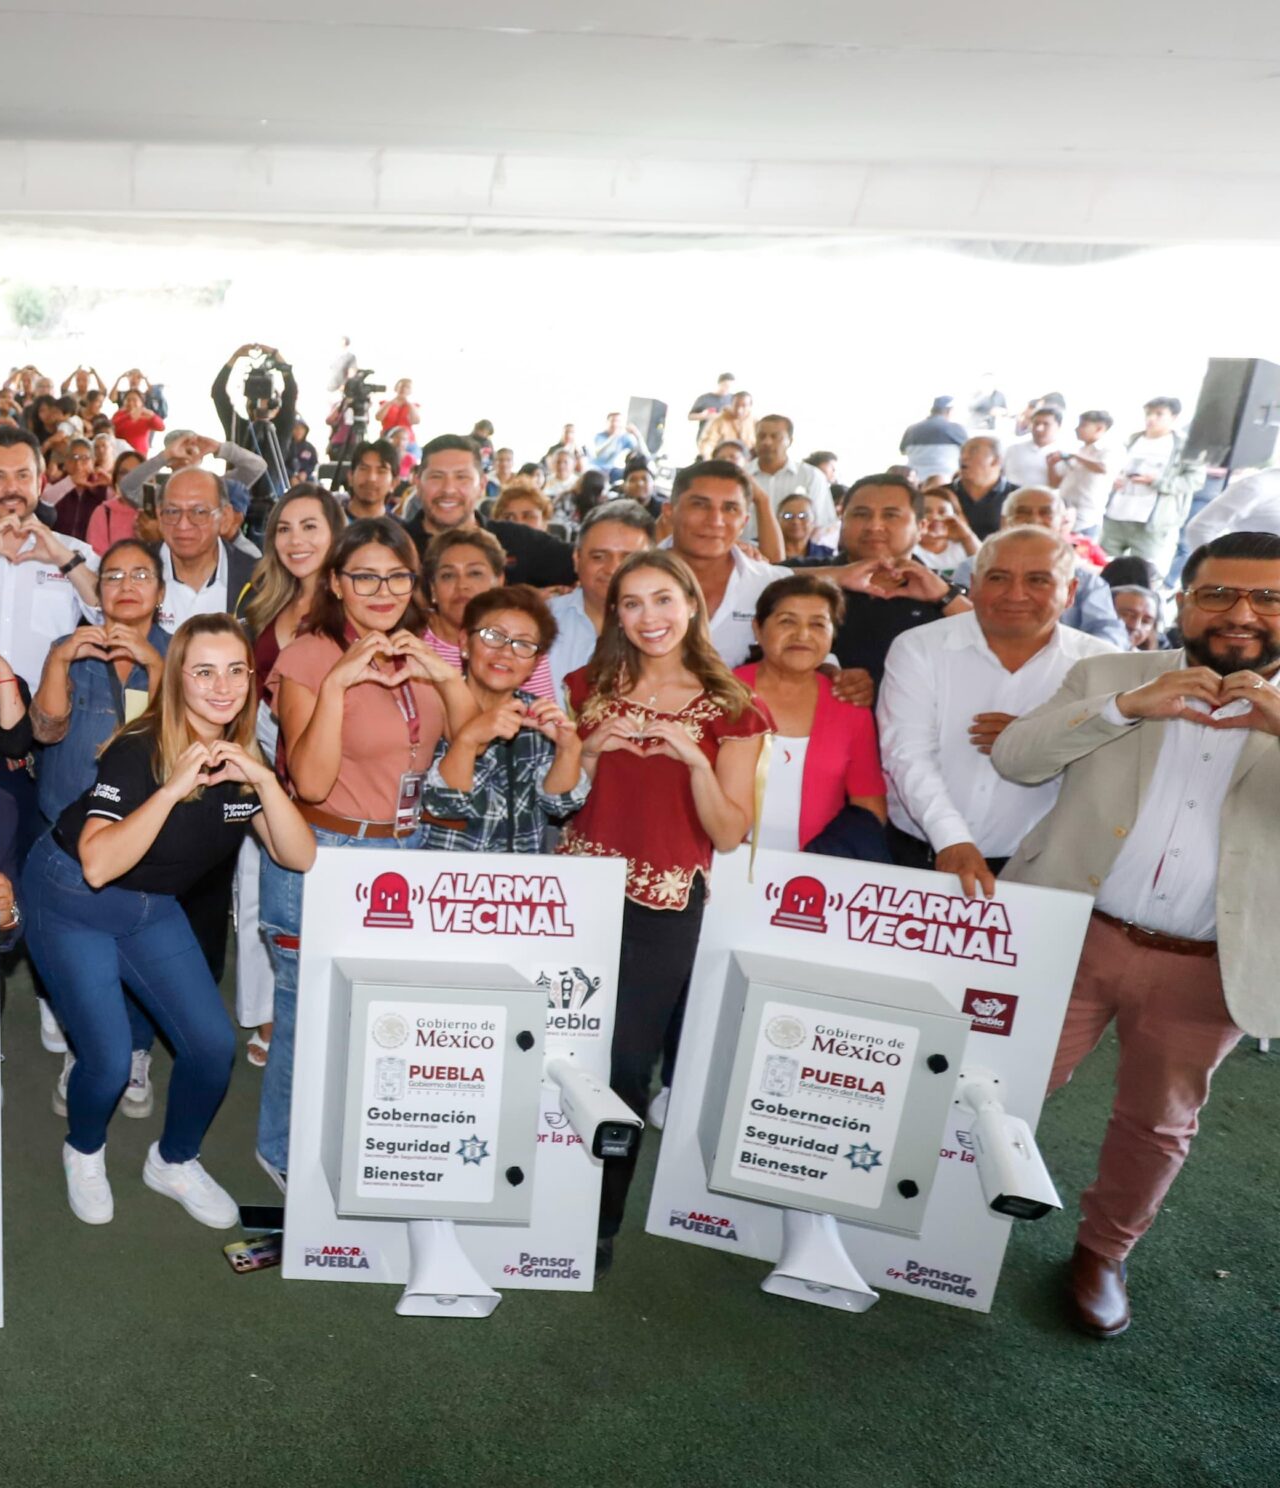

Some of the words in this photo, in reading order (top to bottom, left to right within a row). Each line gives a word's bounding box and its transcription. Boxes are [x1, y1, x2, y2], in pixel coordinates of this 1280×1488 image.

[428, 872, 567, 906] ALARMA
[429, 901, 574, 937] VECINAL
[846, 883, 1012, 935] ALARMA
[848, 909, 1017, 967] VECINAL
[416, 1018, 477, 1030] Gobierno
[481, 1020, 496, 1031] de
[546, 1013, 601, 1031] uebla
[415, 1029, 494, 1049] México
[814, 1024, 884, 1045] Gobierno
[887, 1038, 905, 1049] de
[811, 1035, 901, 1066] México
[409, 1065, 484, 1081] PUEBLA
[800, 1066, 886, 1095] PUEBLA
[408, 1080, 445, 1088] Gobierno
[458, 1082, 486, 1090] Estado
[839, 1088, 854, 1097] del
[854, 1092, 886, 1103] Estado
[367, 1107, 476, 1124] Gobernación
[750, 1098, 871, 1133] Gobernación
[365, 1137, 451, 1155] Seguridad
[552, 1132, 563, 1143] la
[567, 1134, 584, 1146] pa
[745, 1125, 839, 1155] Seguridad
[740, 1151, 828, 1180] Bienestar
[939, 1148, 957, 1159] or
[960, 1150, 976, 1163] la
[363, 1166, 444, 1182] Bienestar
[669, 1215, 739, 1241] PUEBLA
[304, 1254, 370, 1269] PUEBLA
[519, 1252, 575, 1267] Pensar
[520, 1264, 581, 1279] Grande
[905, 1260, 972, 1284] Pensar
[906, 1272, 978, 1298] Grande
